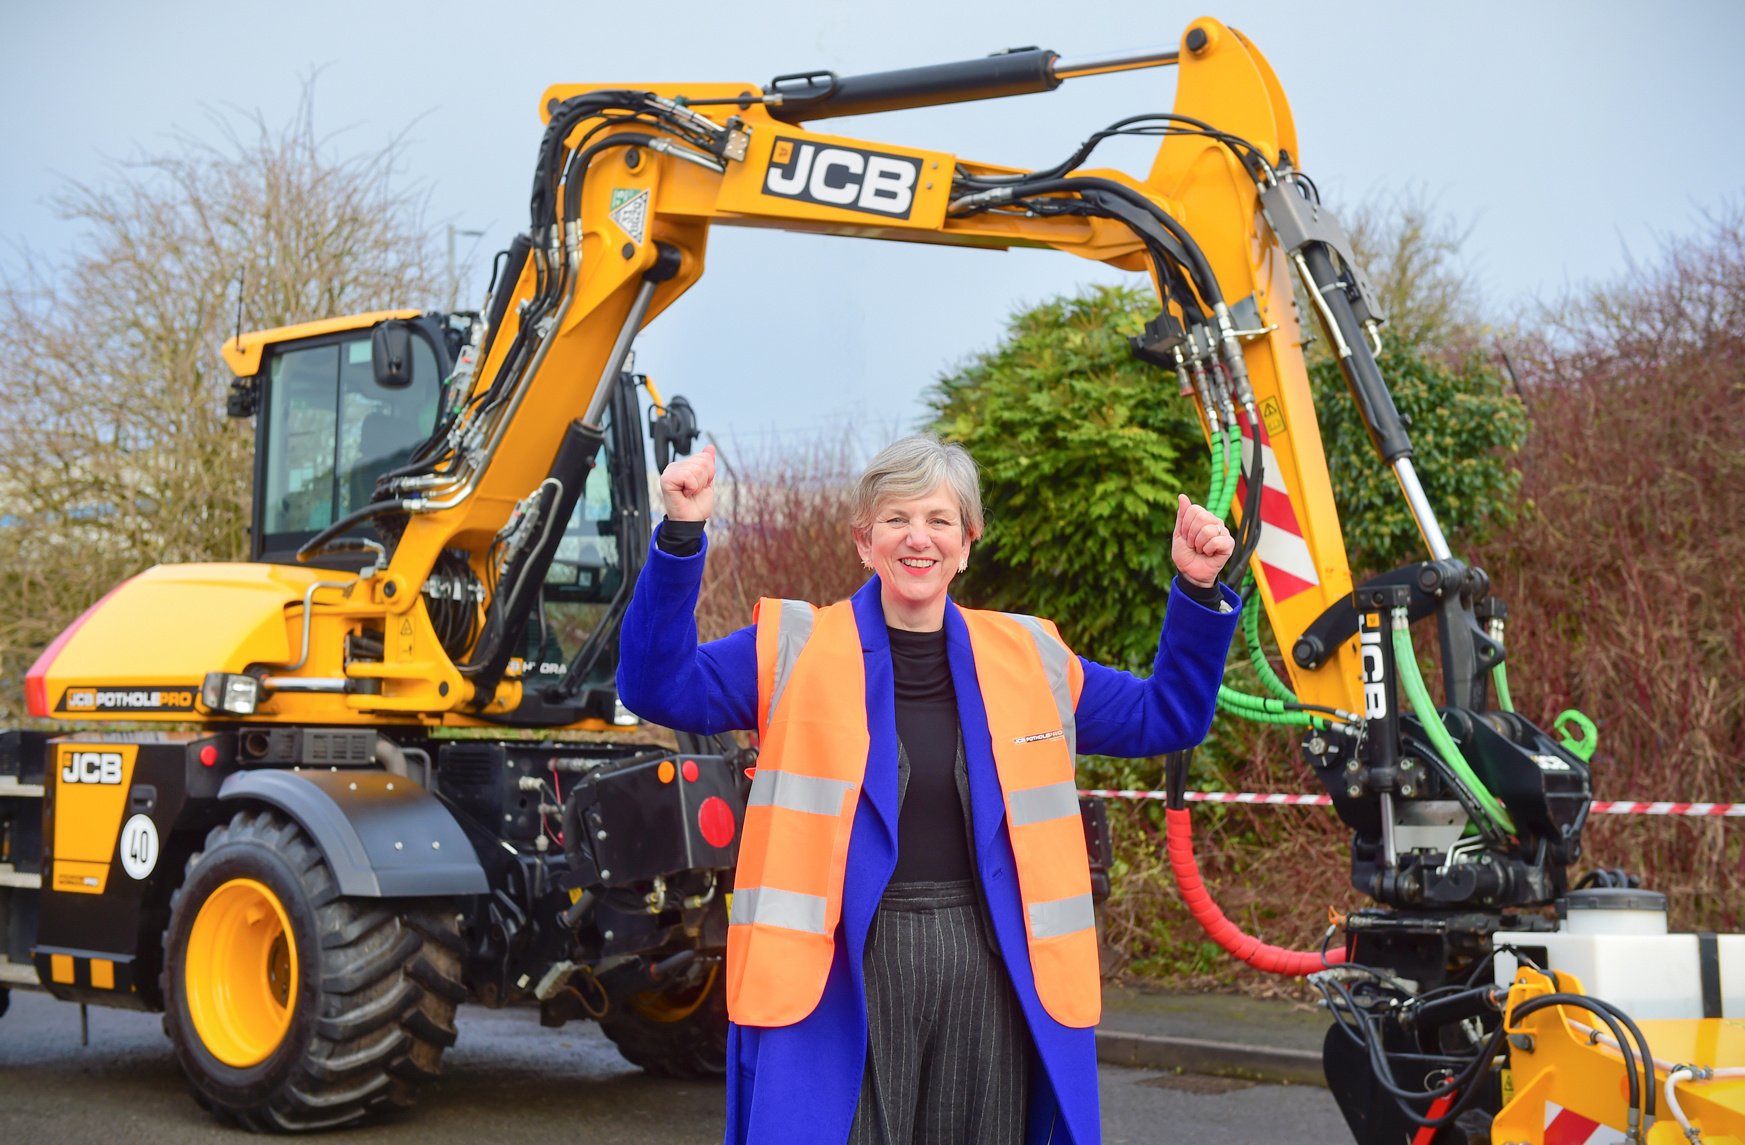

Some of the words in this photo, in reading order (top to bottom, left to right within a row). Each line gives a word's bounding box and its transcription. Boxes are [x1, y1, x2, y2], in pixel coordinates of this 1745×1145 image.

[766, 144, 917, 214] JCB
[1358, 613, 1387, 720] JCB
[69, 692, 94, 707] JCB
[62, 752, 123, 785] JCB
[131, 829, 149, 863] 40
